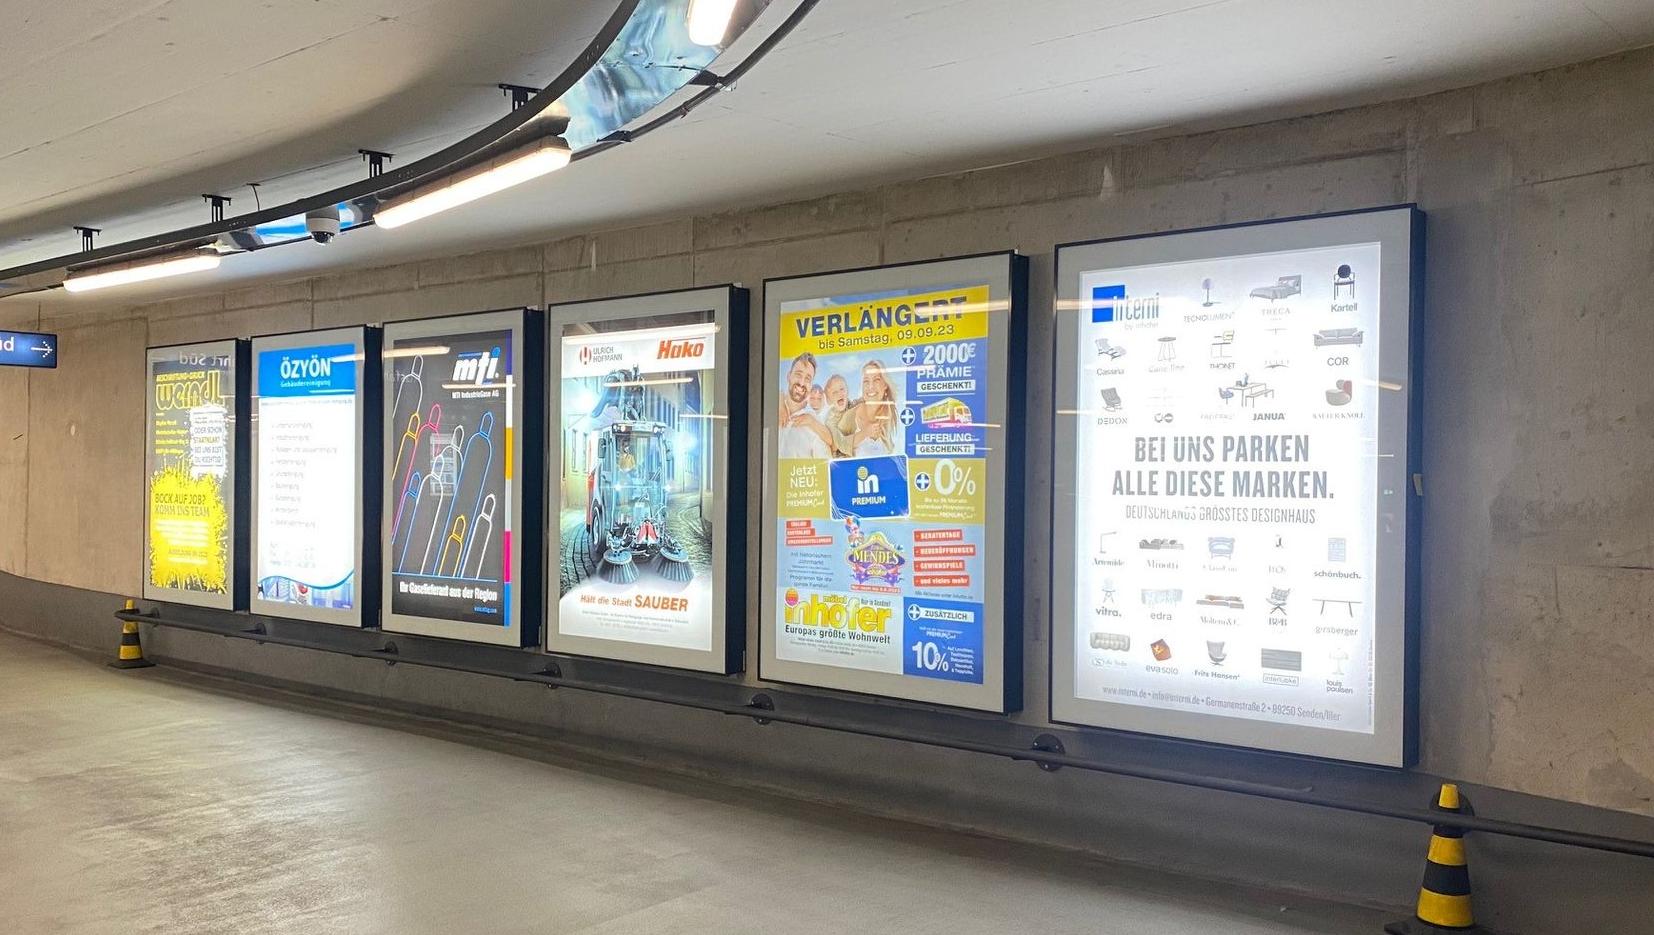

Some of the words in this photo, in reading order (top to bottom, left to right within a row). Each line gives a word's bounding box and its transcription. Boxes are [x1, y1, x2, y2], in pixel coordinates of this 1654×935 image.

[1331, 303, 1358, 312] Kartell
[796, 296, 967, 338] VERLÄNGERT
[818, 338, 835, 350] bis
[837, 332, 893, 348] Samstag,
[897, 325, 954, 341] 09.09.23
[593, 346, 614, 355] ULRICH
[656, 340, 705, 360] Hako
[593, 354, 623, 363] HOFMANN
[1327, 357, 1349, 366] COR
[280, 354, 331, 379] ÖZYÖN
[917, 365, 972, 379] PRÄMIE
[920, 381, 972, 391] GESCHENKT!
[1252, 412, 1285, 421] JANUA
[916, 432, 972, 443] LIEFERUNG
[919, 445, 972, 453] GESCHENKT!
[1134, 436, 1166, 462] BEI
[1173, 435, 1215, 463] UNS
[1222, 435, 1309, 463] PARKEN
[790, 464, 816, 476] Jetzt
[790, 476, 818, 488] NEU:
[857, 466, 880, 494] in
[934, 458, 976, 496] 0%
[1112, 470, 1159, 496] ALLE
[1165, 470, 1225, 497] DIESE
[1232, 471, 1334, 499] MARKEN.
[154, 493, 173, 504] BOCK
[174, 493, 188, 505] AUF
[851, 496, 886, 506] PREMIUM
[190, 506, 210, 517] TEAM
[1125, 505, 1196, 520] DEUTSCHLANDS
[1251, 507, 1316, 524] DESIGNHAUS
[449, 587, 461, 598] aus
[462, 586, 474, 599] der
[474, 587, 498, 602] Region
[580, 594, 596, 605] Hält
[597, 596, 610, 606] die
[611, 597, 632, 607] Stadt
[634, 594, 689, 612] SAUBER
[924, 609, 967, 620] ZUSÄTZLICH
[1095, 606, 1122, 617] vitra.
[1150, 611, 1172, 621] edra
[785, 624, 816, 637] Europas
[819, 629, 846, 640] größte
[848, 631, 890, 644] Wohnwelt
[912, 641, 949, 672] 10%
[1194, 669, 1209, 678] Frits
[1205, 697, 1260, 712] Germanenstraße
[1261, 703, 1266, 711] 2
